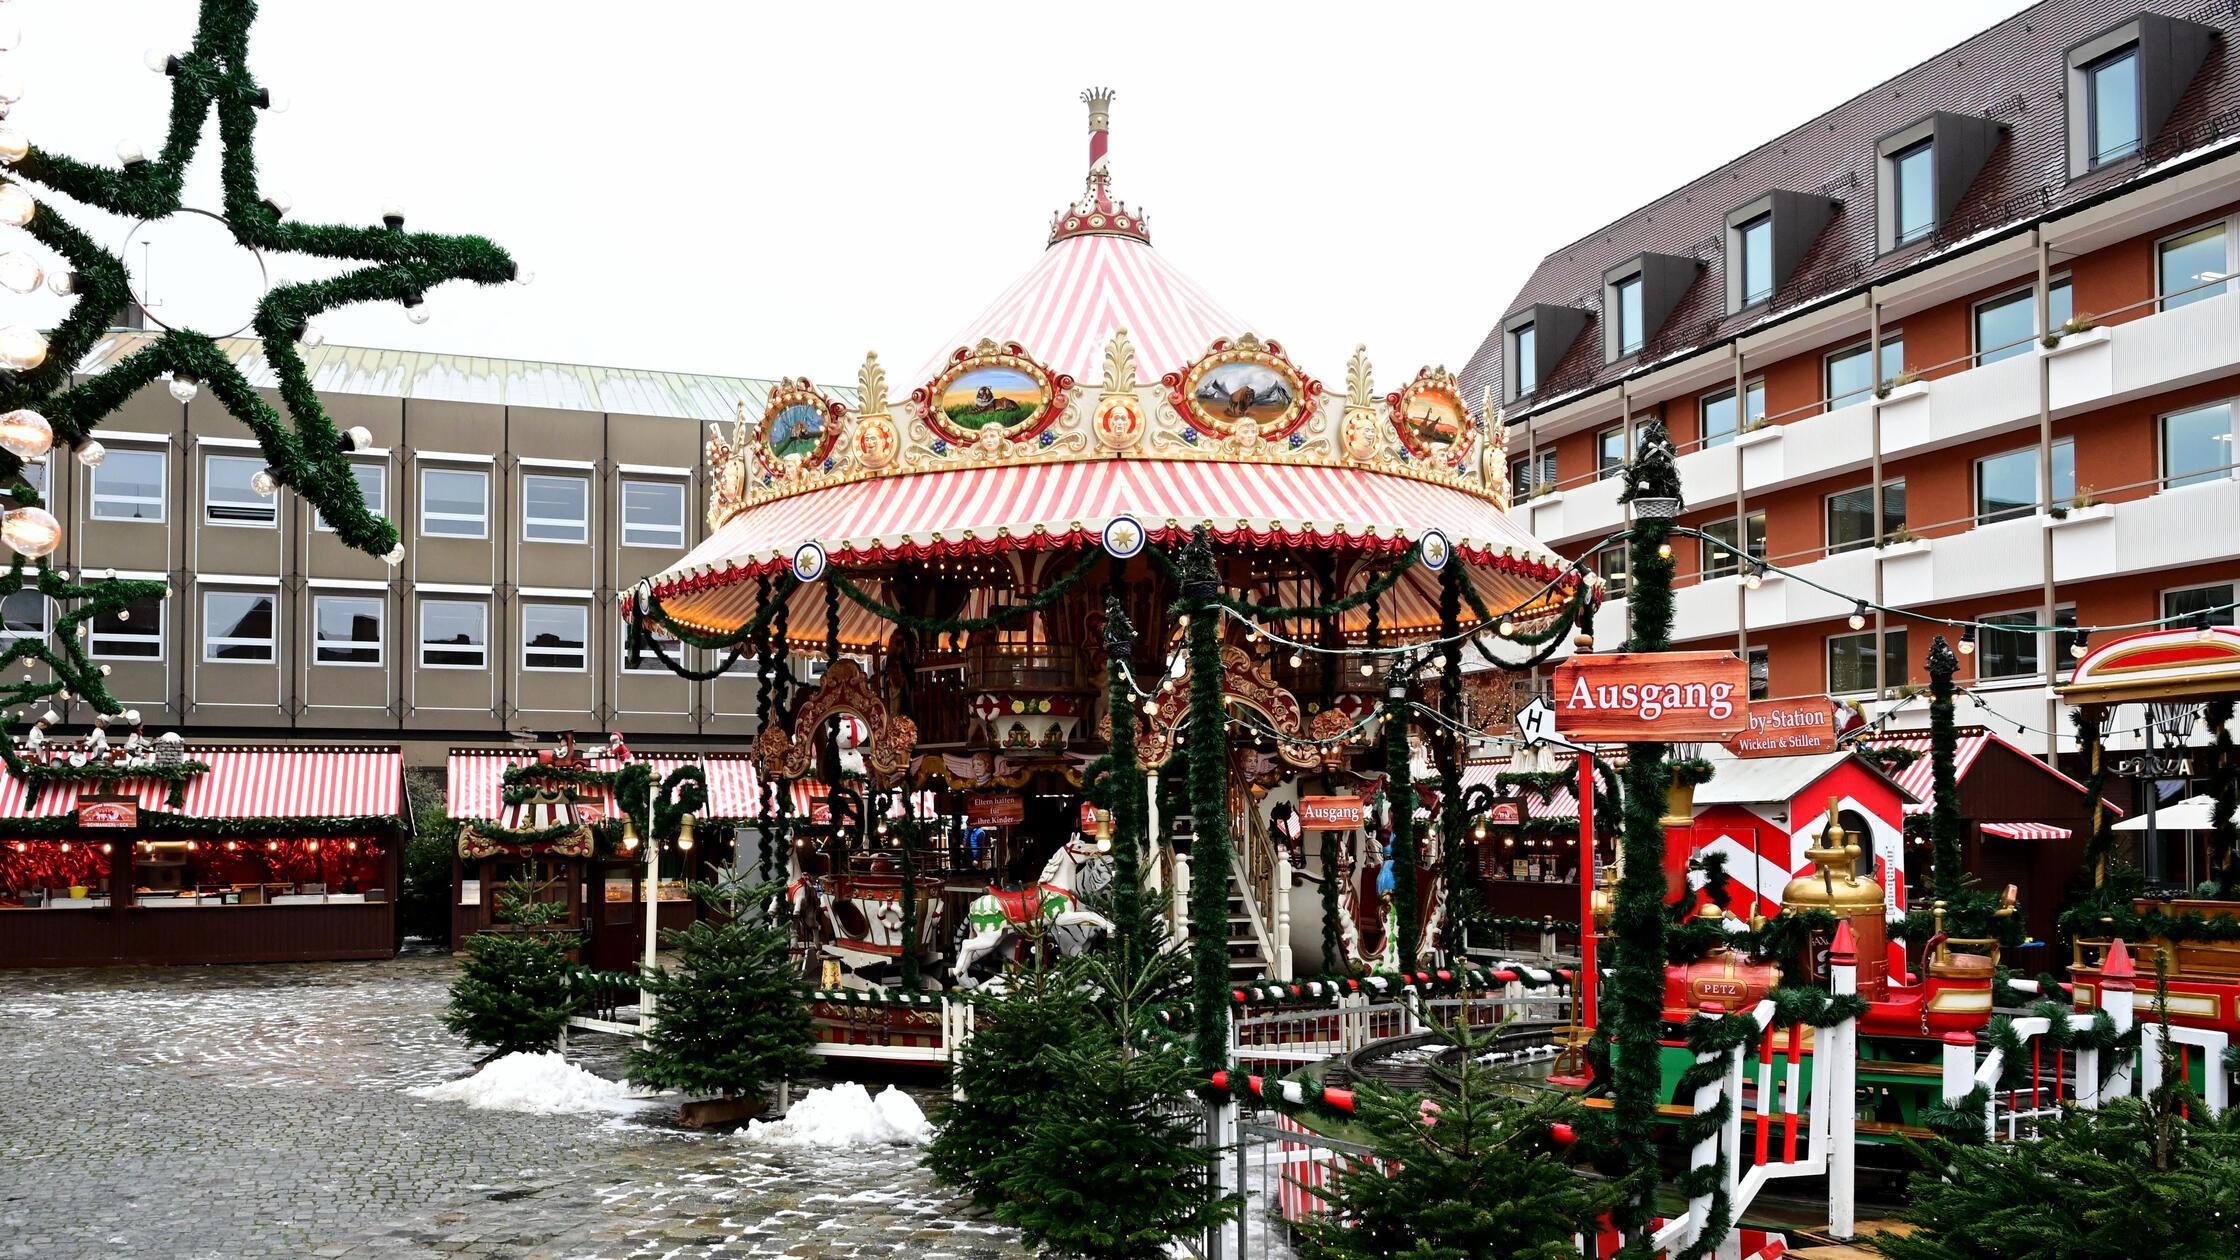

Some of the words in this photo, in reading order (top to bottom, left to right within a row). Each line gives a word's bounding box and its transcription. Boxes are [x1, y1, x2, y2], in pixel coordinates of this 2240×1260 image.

[1565, 675, 1735, 721] Ausgang
[1525, 708, 1543, 733] H
[1747, 707, 1825, 735] by-Station
[1739, 737, 1777, 751] Wickeln
[1778, 738, 1788, 748] &
[1789, 734, 1821, 747] Stillen
[974, 798, 994, 806] Eltern
[990, 807, 1000, 815] für
[1304, 804, 1360, 823] Ausgang
[991, 816, 1014, 824] Kinder
[1703, 984, 1736, 995] PETZ
